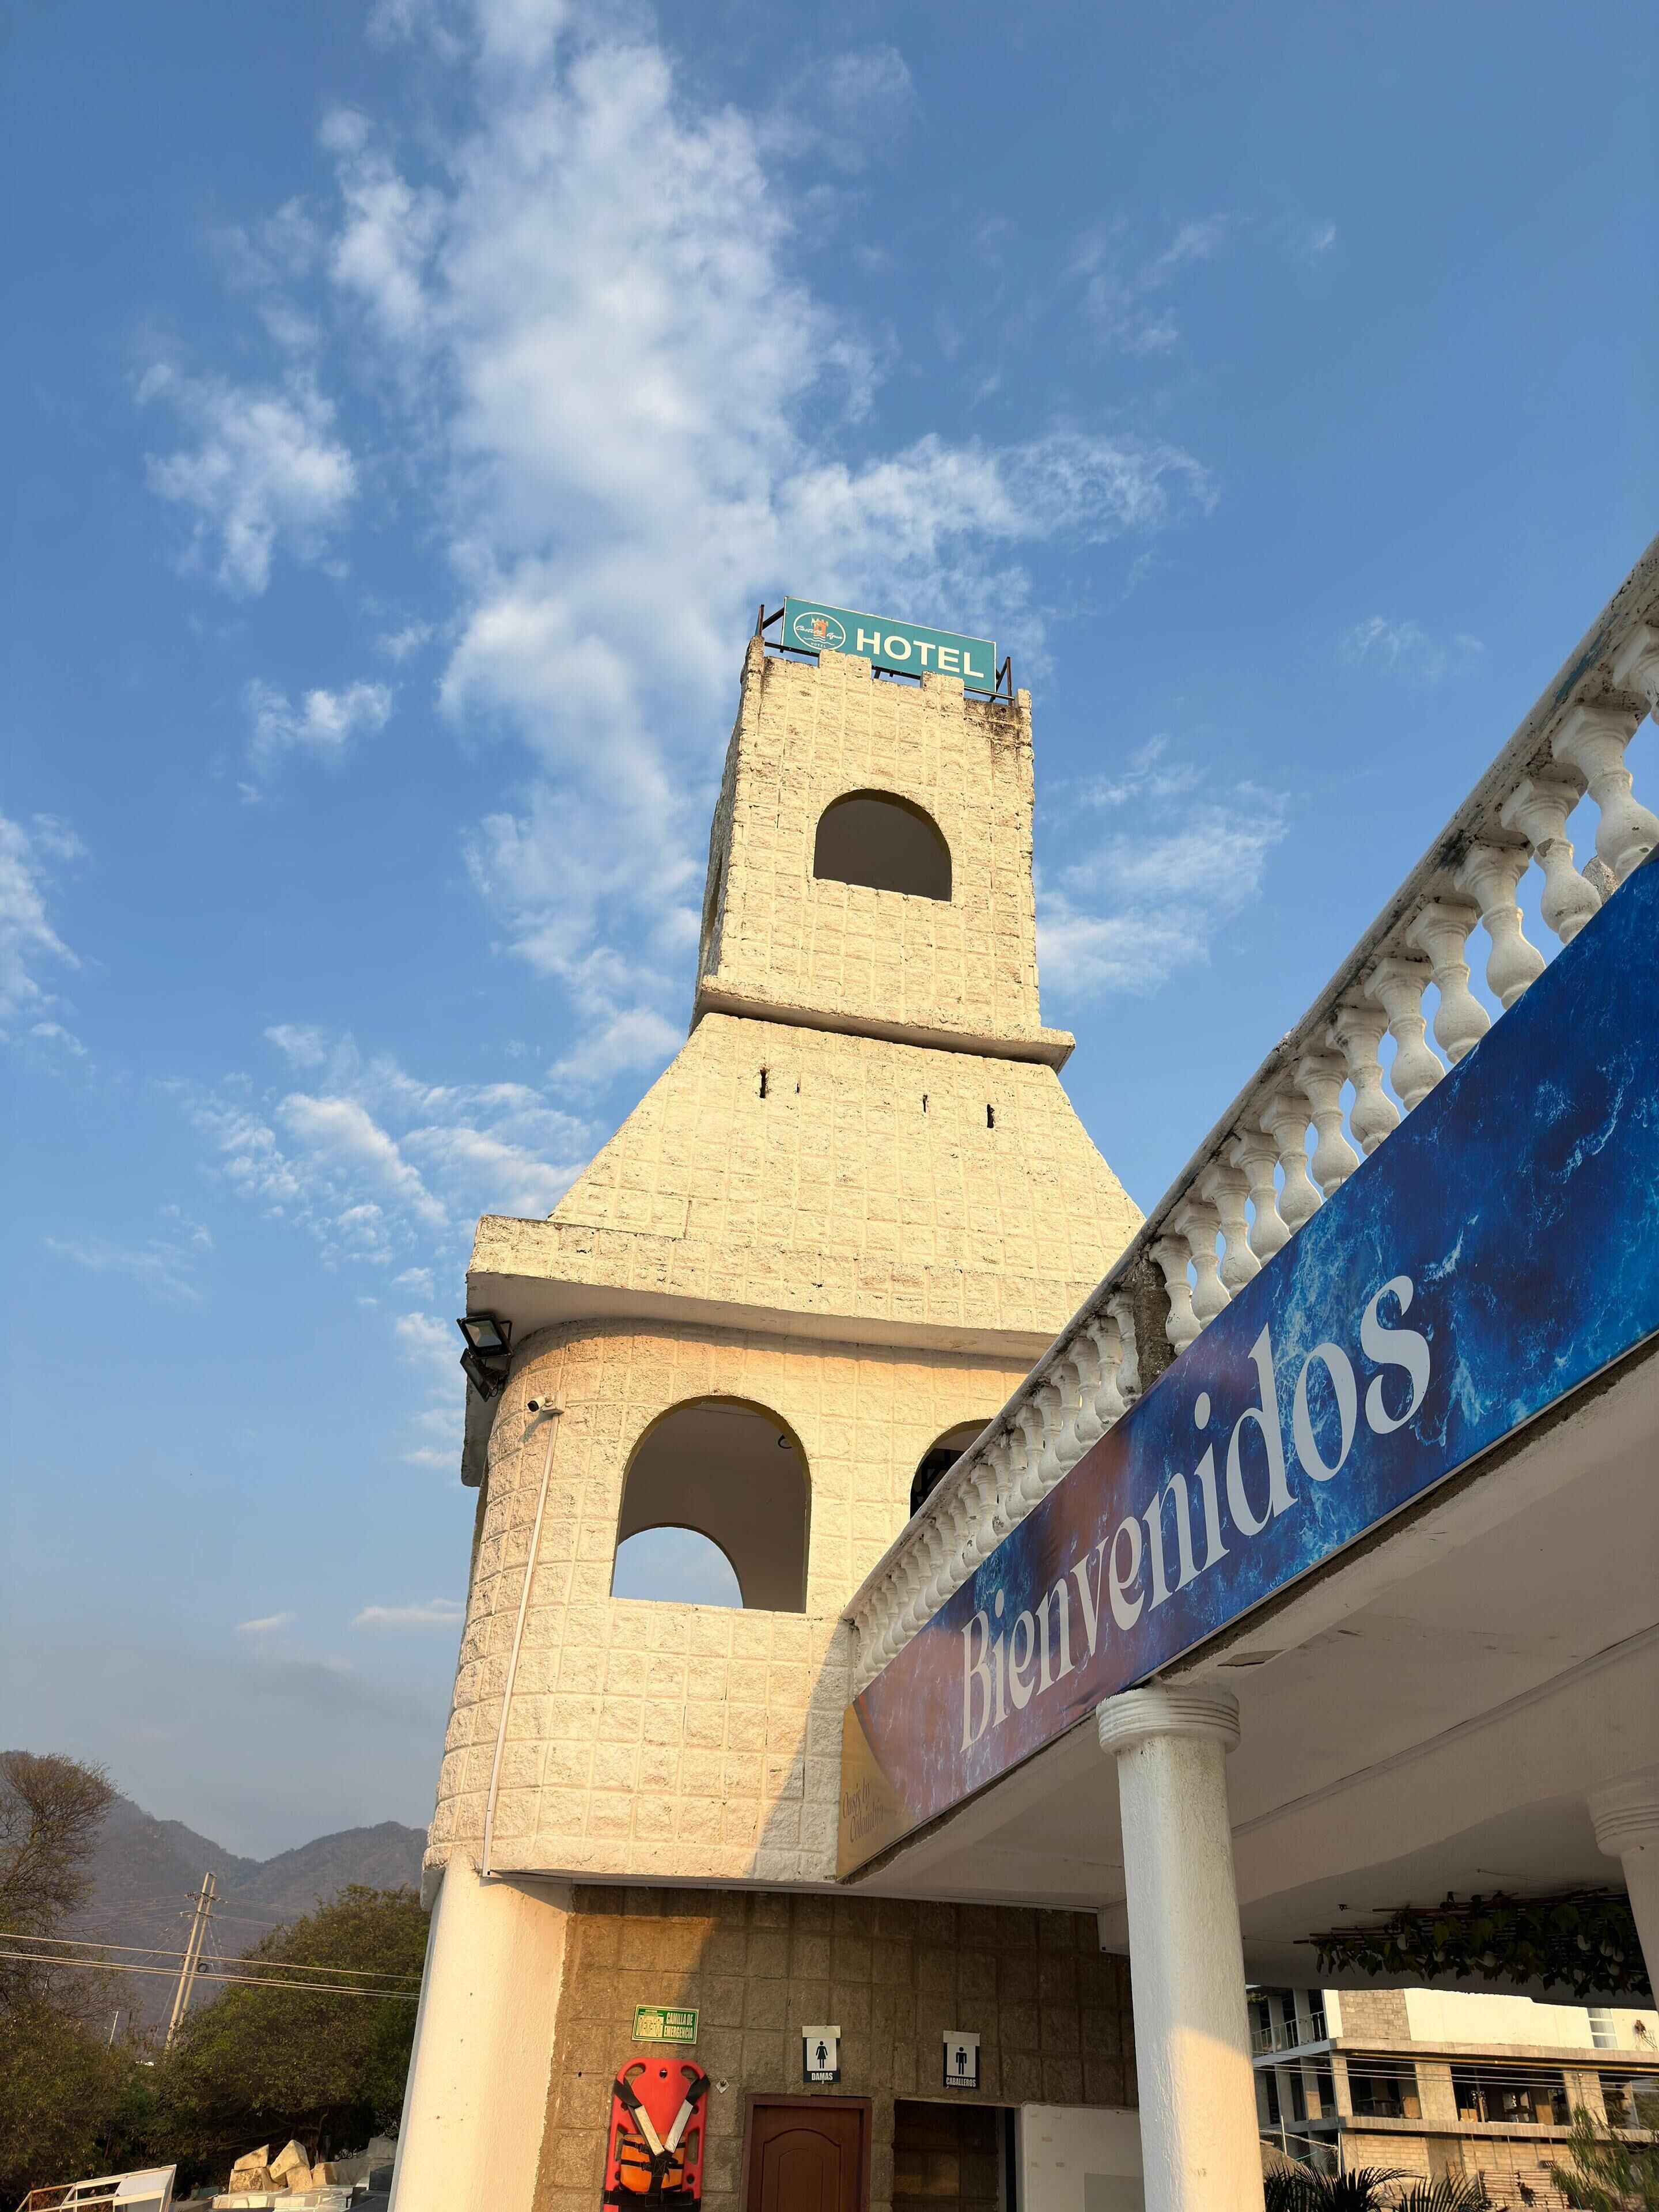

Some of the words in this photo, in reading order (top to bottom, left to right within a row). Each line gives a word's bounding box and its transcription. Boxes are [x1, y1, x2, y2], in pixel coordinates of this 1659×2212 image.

[857, 628, 984, 678] HOTEL
[960, 1275, 1430, 1753] Bienvenidos
[843, 1783, 861, 1819] Oasis
[850, 1797, 884, 1843] Colombia
[666, 2012, 686, 2025] CAMILLA
[687, 2014, 694, 2026] DE
[664, 2025, 693, 2039] EMERGENCIA
[811, 2072, 833, 2081] DAMAS
[946, 2077, 976, 2088] CABALLEROS
